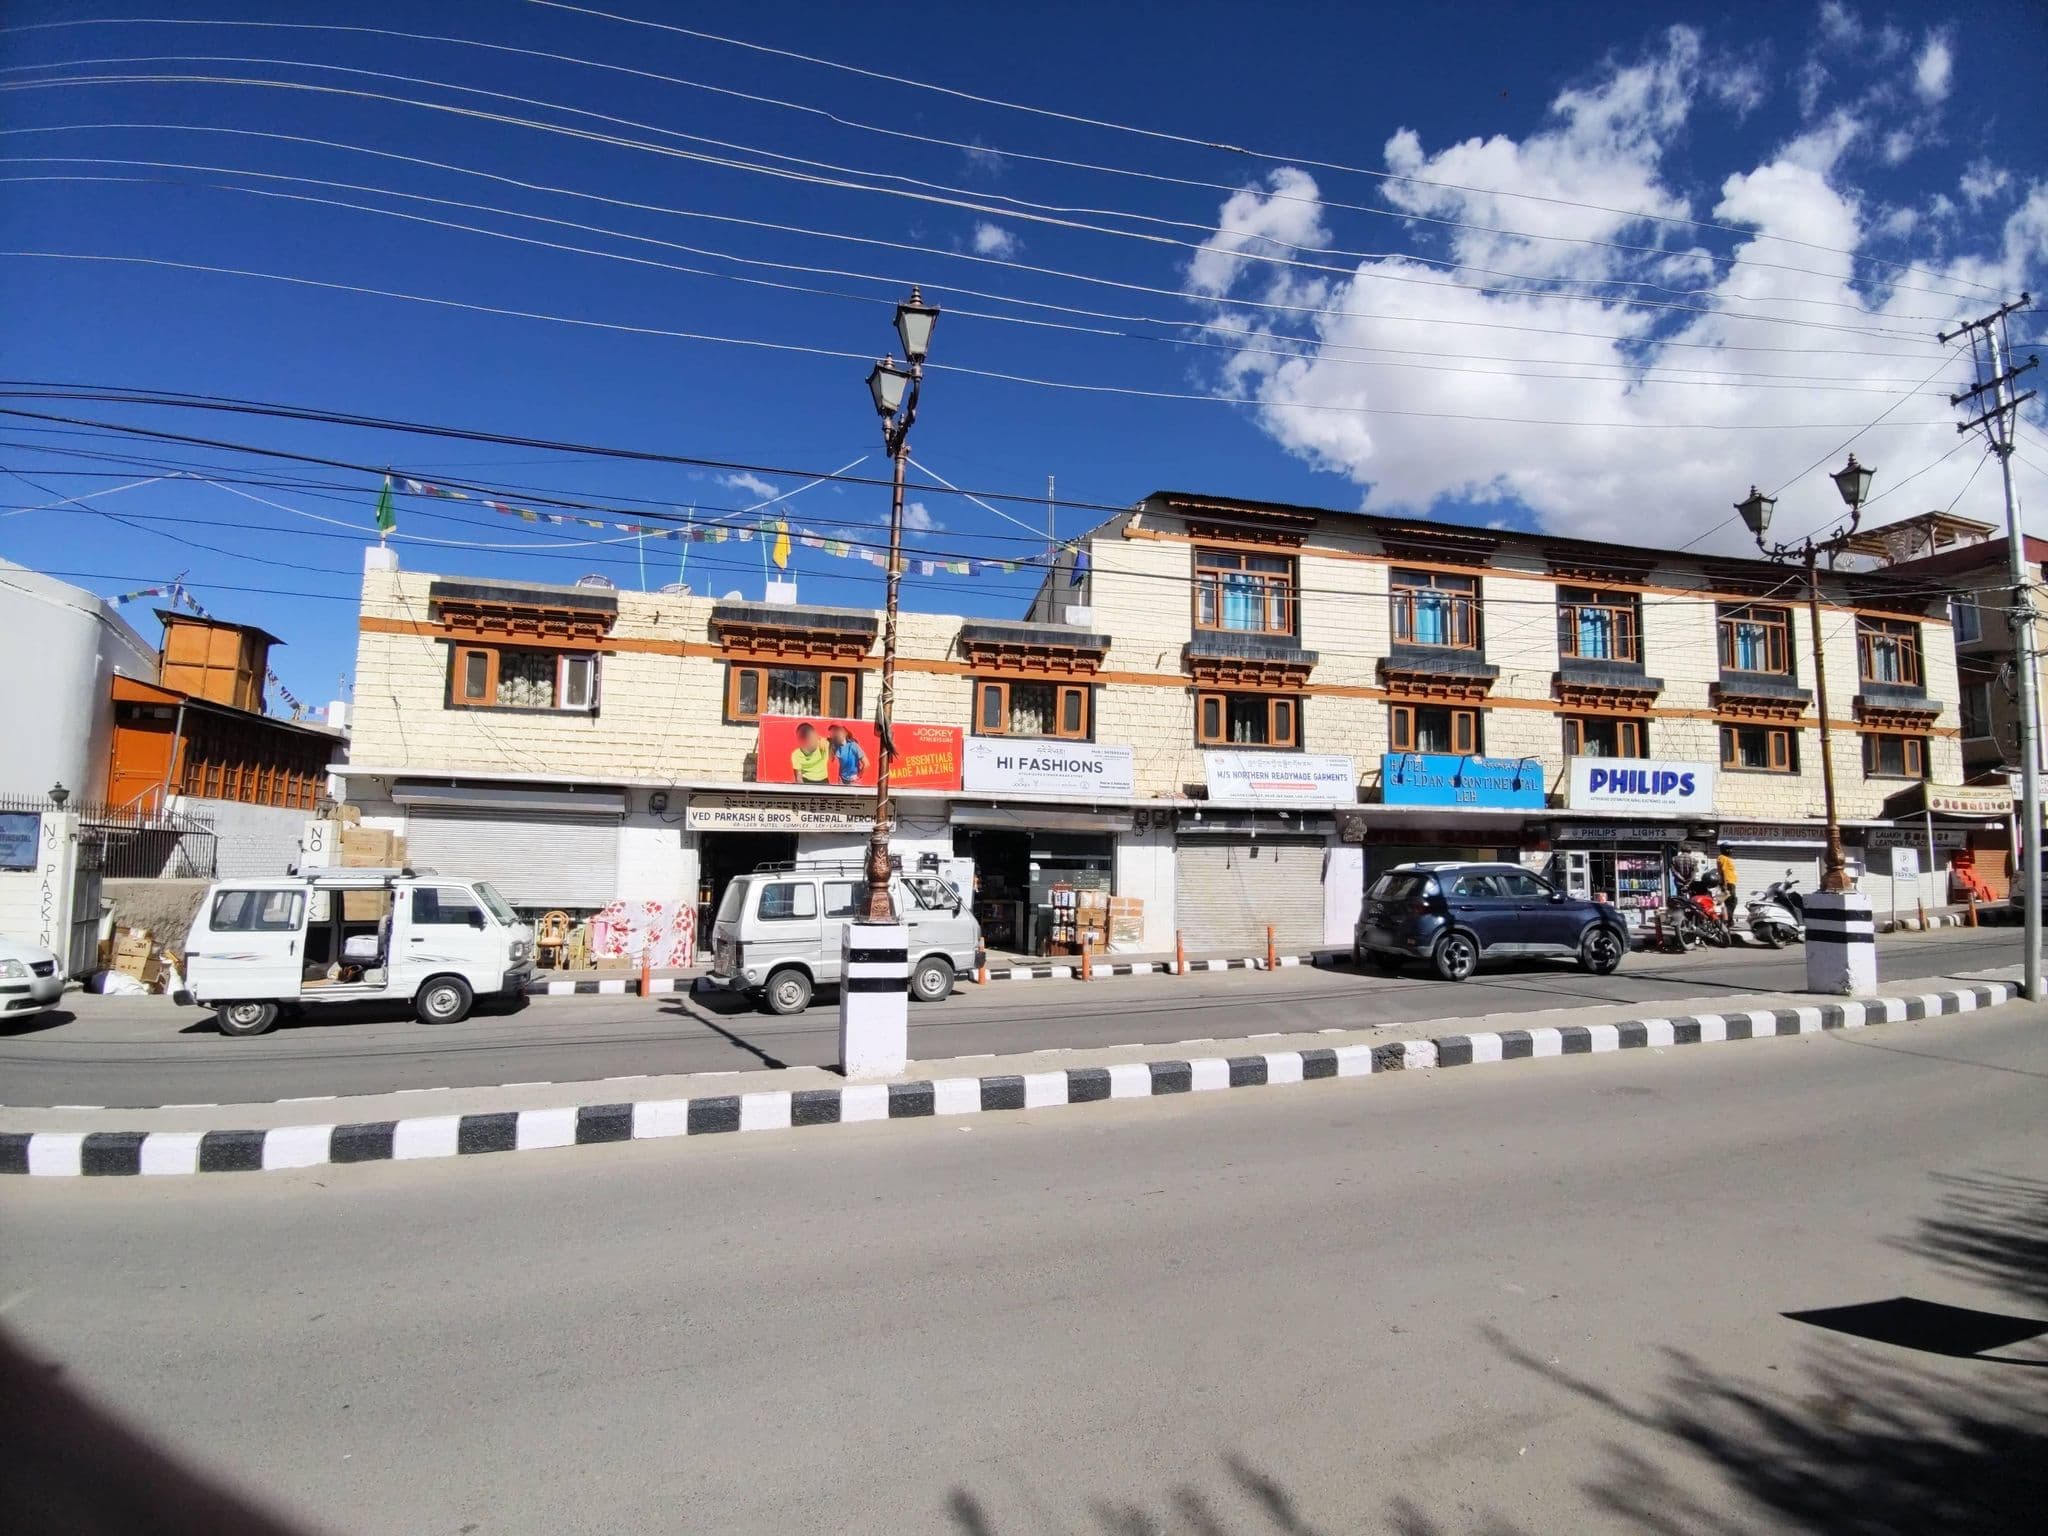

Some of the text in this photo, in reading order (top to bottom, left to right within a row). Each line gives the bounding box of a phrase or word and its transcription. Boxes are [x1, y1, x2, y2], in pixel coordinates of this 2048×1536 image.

[912, 728, 953, 738] JOCKEY
[906, 752, 953, 767] ESSENTIALS
[997, 757, 1013, 769] HI
[1019, 757, 1103, 774] FASHIONS
[889, 763, 954, 779] MADE AMAZING
[1217, 771, 1348, 781] M/S NORTHERN READYMADE GARMENTS
[1390, 774, 1443, 787] G-LDAN
[1590, 768, 1695, 797] PHILIPS
[1455, 791, 1477, 802] LEH
[692, 812, 894, 823] VED PARKASH & BROS GENERAL MERCHT
[1581, 829, 1666, 837] PHILIPS LIGHTS
[1722, 826, 1828, 838] HANDICRAFTS INDUSTRIA
[310, 827, 323, 852] NO
[40, 823, 57, 949] NO PARKIN
